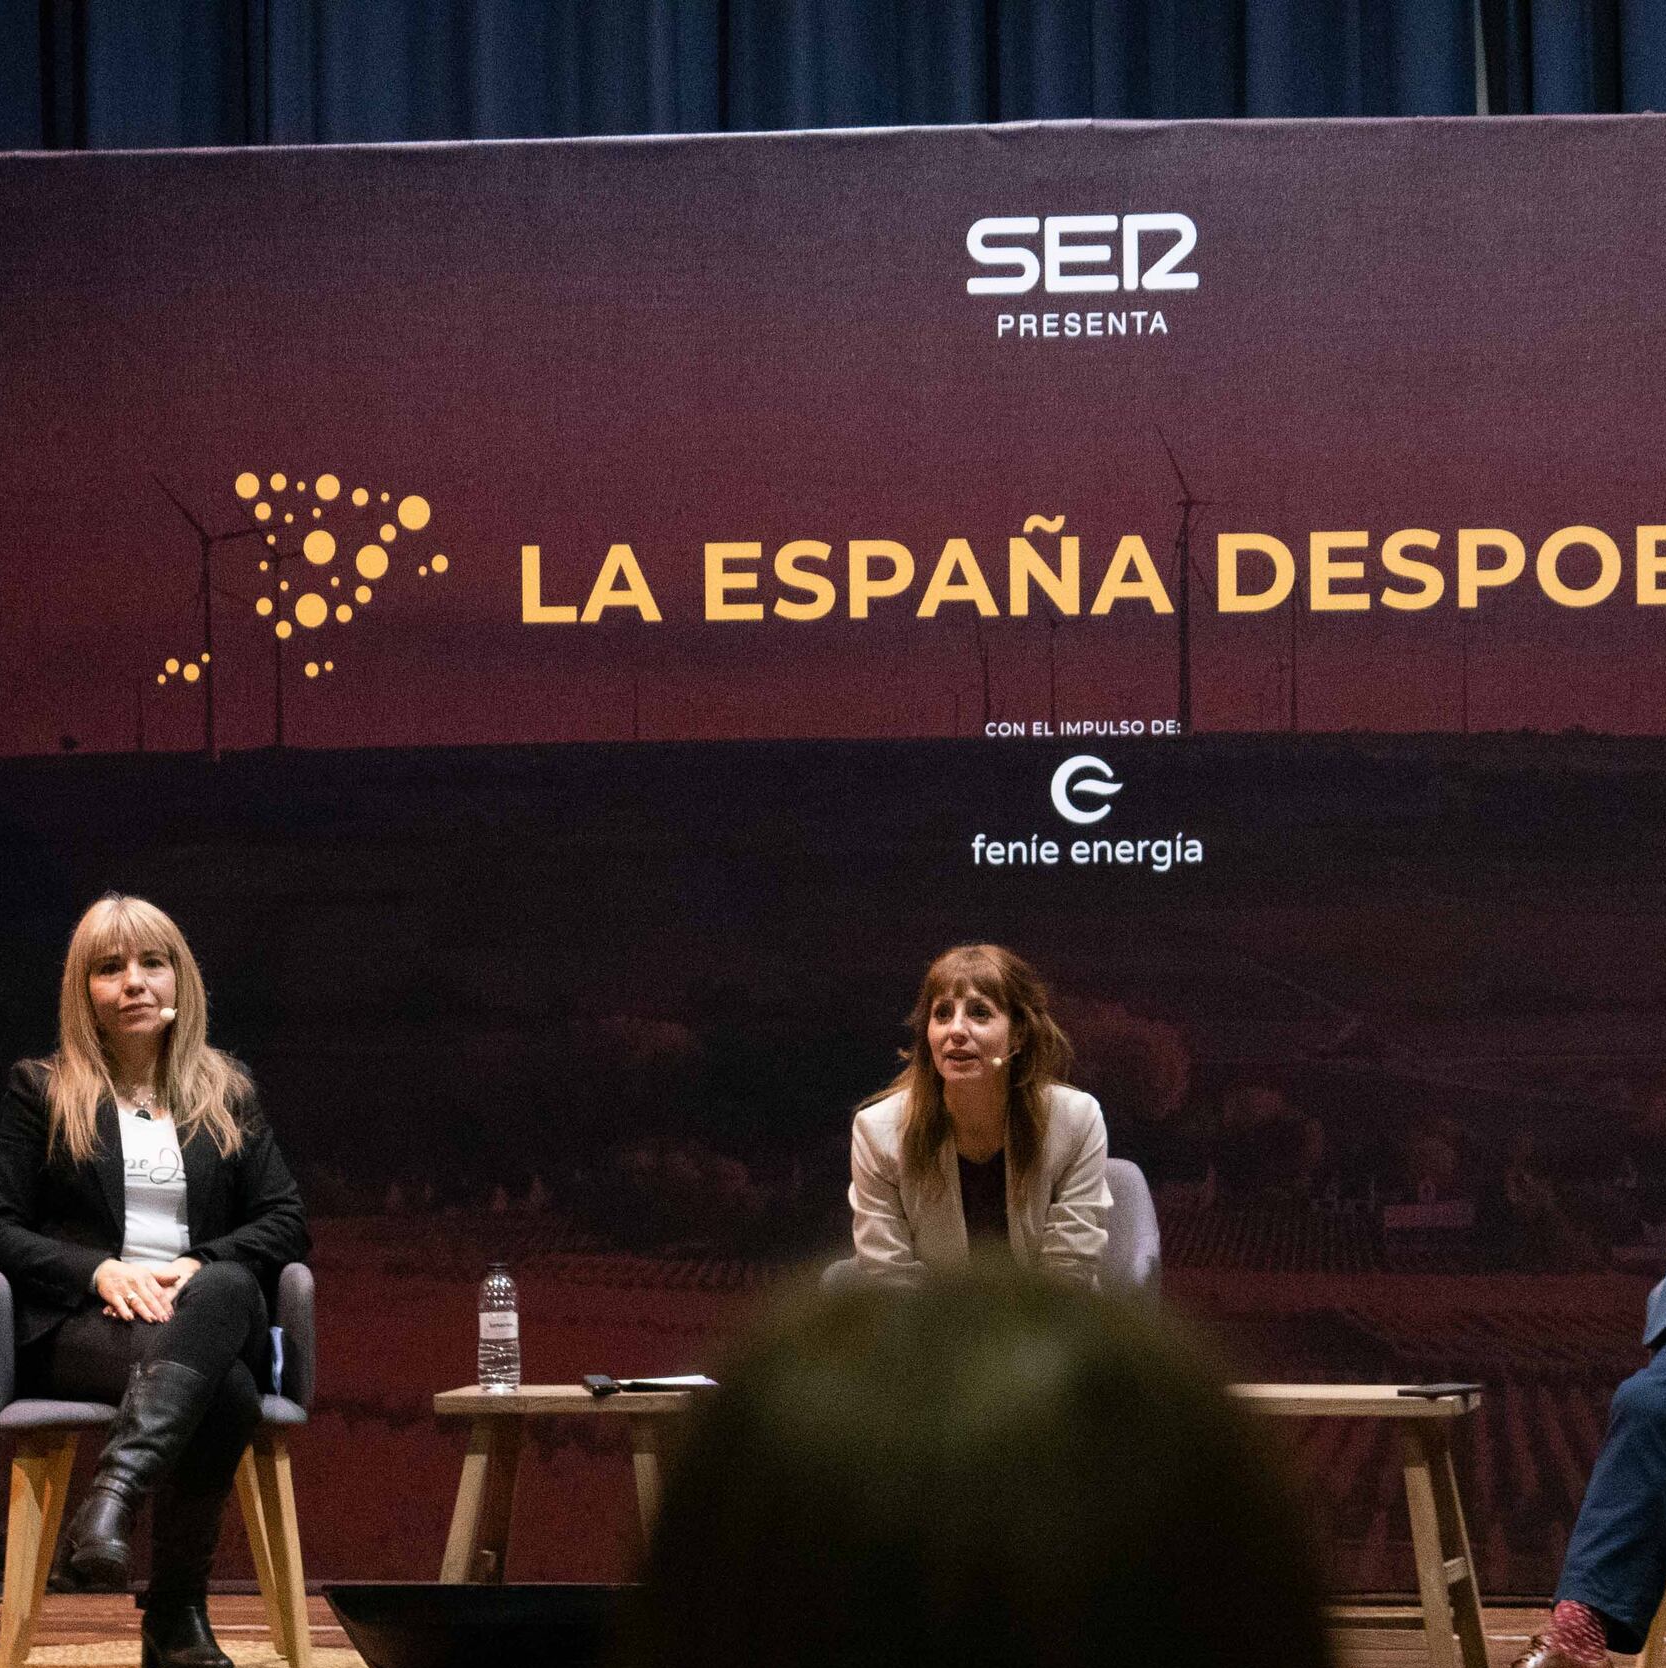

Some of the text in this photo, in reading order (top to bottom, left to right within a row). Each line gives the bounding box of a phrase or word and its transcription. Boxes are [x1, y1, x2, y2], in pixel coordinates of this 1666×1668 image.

[966, 212, 1200, 295] SER
[997, 310, 1168, 338] PRESENTA
[521, 543, 663, 623] LA
[704, 514, 1175, 621] ESPAÑA
[985, 719, 1181, 737] CON EL IMPULSO DE:
[1070, 831, 1203, 872] energía
